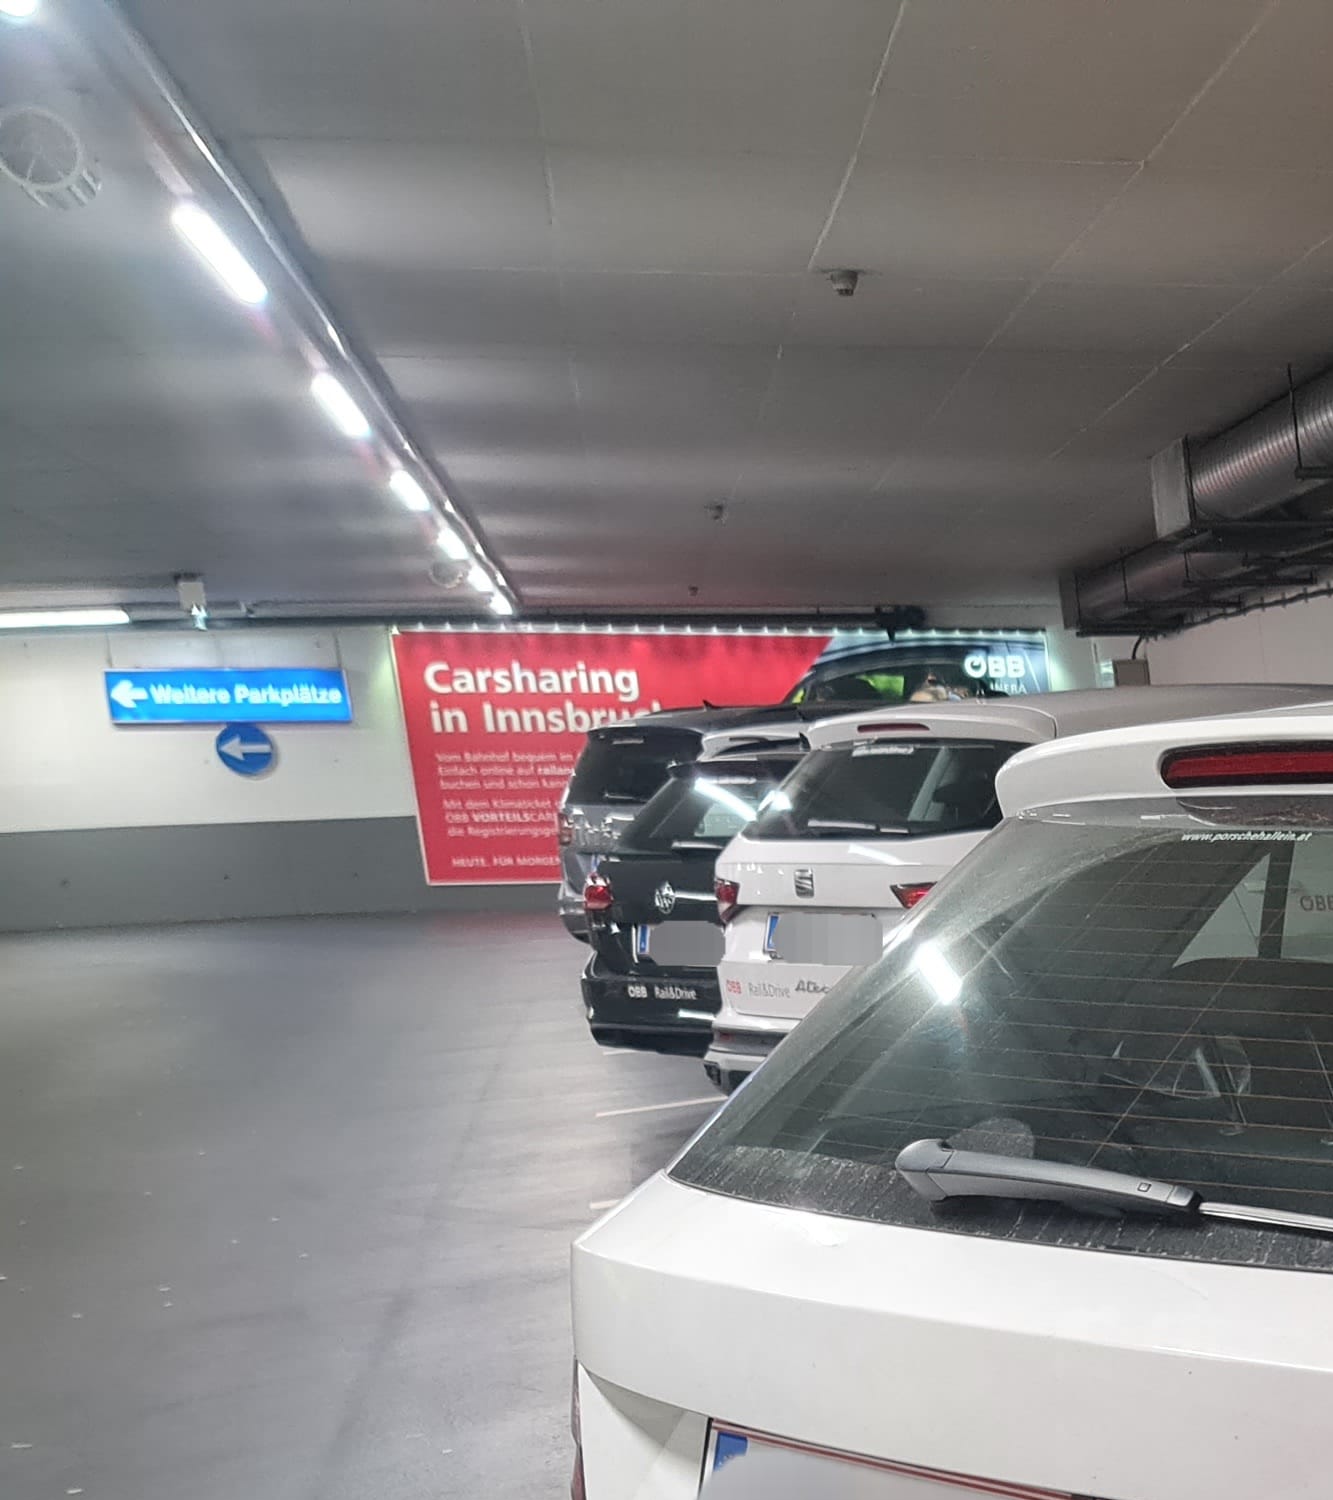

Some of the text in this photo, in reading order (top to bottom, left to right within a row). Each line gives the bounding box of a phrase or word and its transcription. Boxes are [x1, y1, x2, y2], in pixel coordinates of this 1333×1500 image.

[423, 660, 640, 703] Carsharing
[150, 683, 343, 707] Weitere Parkplätze
[429, 699, 662, 734] in Innsbru
[1181, 828, 1313, 843] www.porschehallein.at
[654, 985, 697, 1000] Rail&Drive
